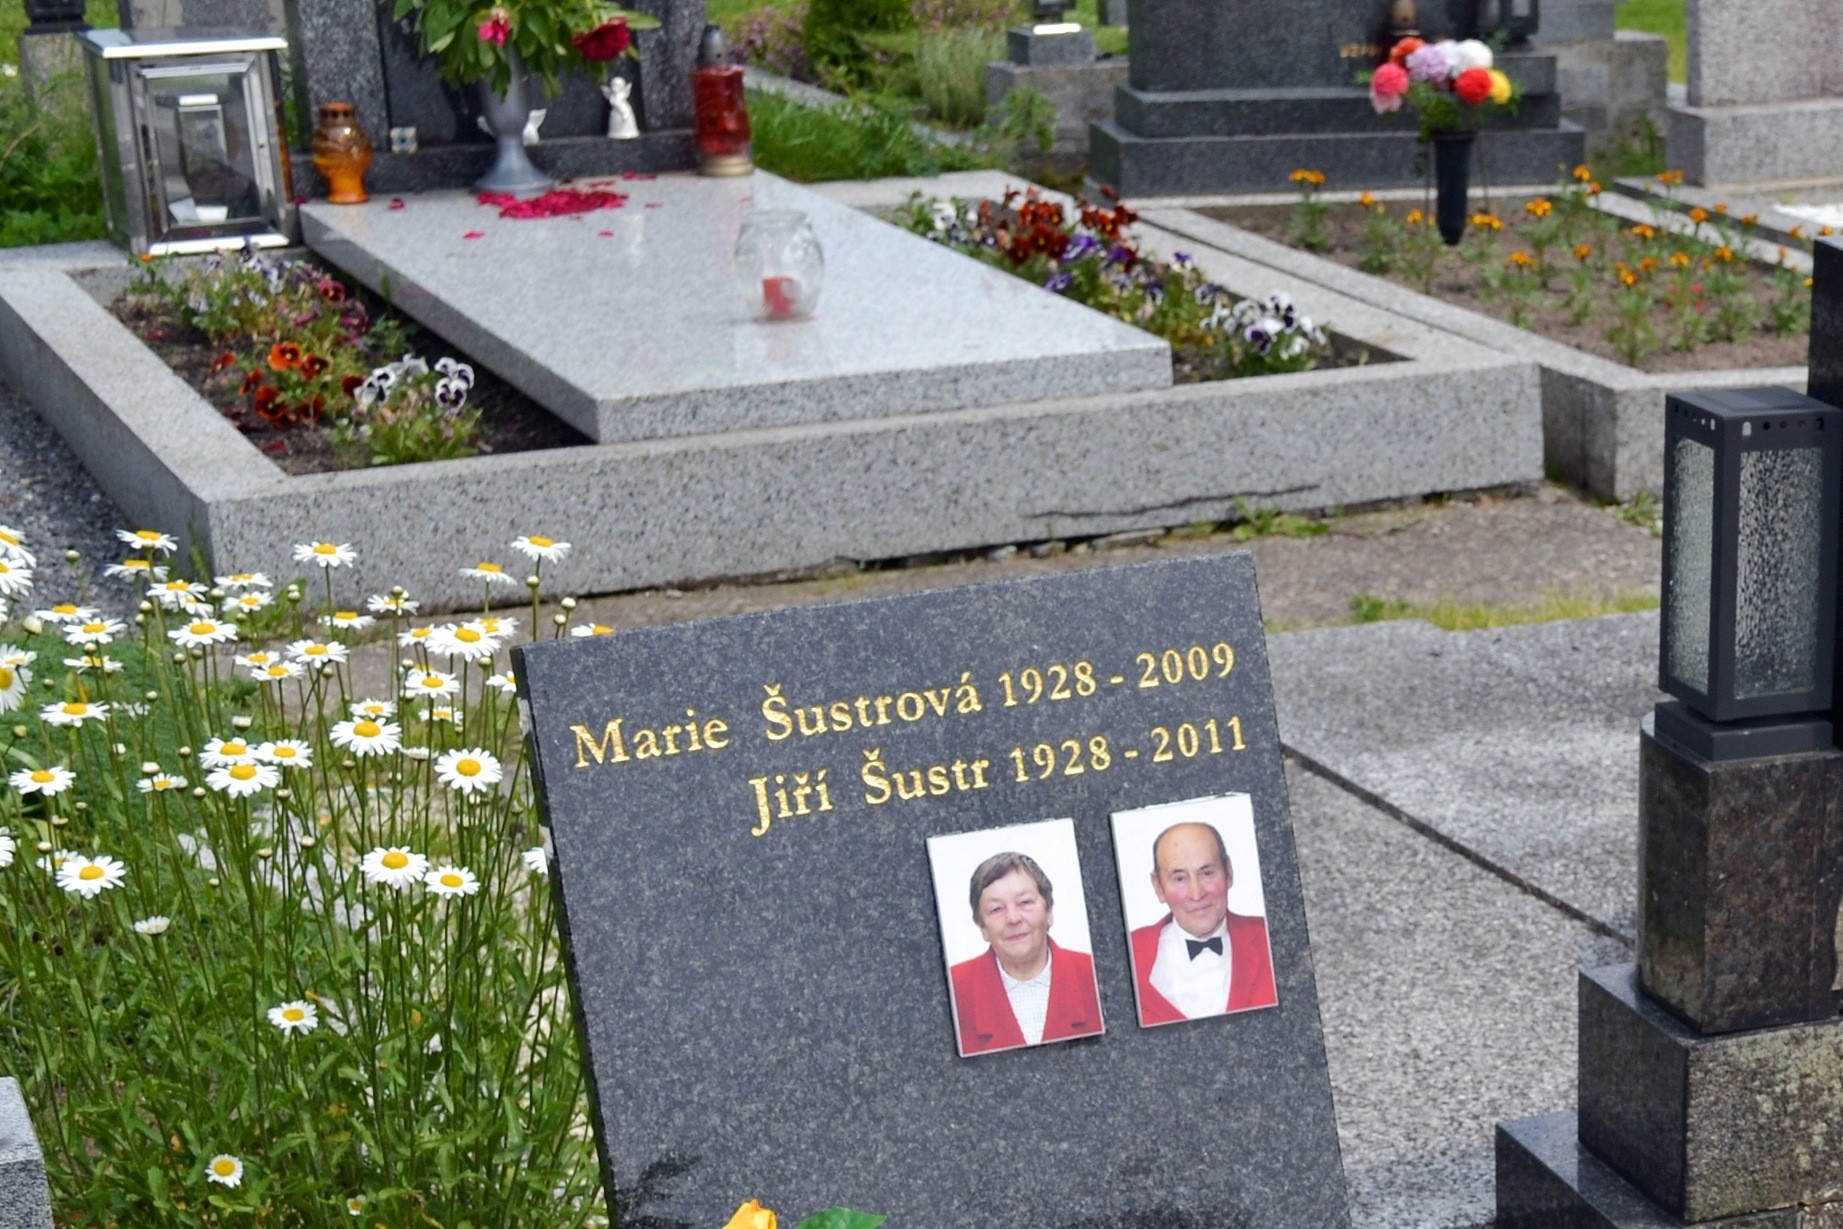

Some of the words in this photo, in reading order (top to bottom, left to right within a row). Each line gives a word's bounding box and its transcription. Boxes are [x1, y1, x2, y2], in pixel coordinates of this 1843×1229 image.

[569, 708, 732, 767] Marie
[760, 670, 983, 741] Šustrová
[999, 660, 1098, 707] 1928
[1136, 641, 1236, 688] 2009
[749, 768, 835, 838] Jiří
[861, 749, 991, 807] Šustr
[1009, 734, 1112, 782] 1928
[1150, 714, 1249, 764] 2011
